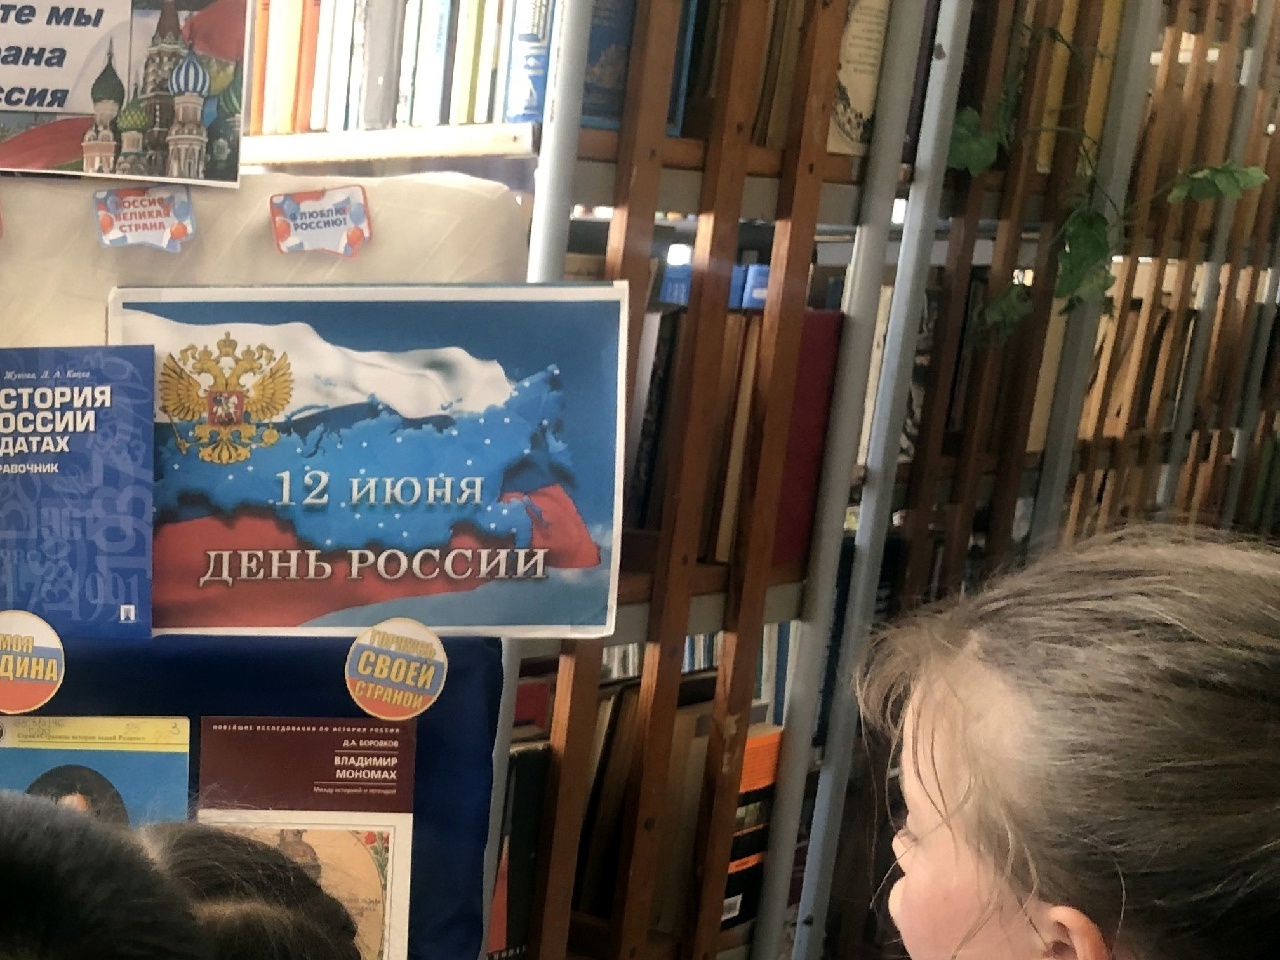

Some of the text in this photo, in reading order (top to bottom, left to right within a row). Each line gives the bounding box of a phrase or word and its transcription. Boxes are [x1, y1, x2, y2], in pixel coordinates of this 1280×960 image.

[46, 6, 104, 27] мы
[115, 196, 165, 209] РОССИЯ
[114, 208, 171, 222] ВЕЛИКАЯ
[300, 207, 347, 221] ЛЮБЛЮ
[119, 221, 166, 233] СТРАНА
[293, 217, 347, 232] РОССИЮ!
[274, 470, 329, 506] 12
[199, 548, 549, 587] ДЕНЬ РОССИИ
[357, 650, 435, 690] СВОЕЙ
[356, 680, 424, 711] СТРАНОЙ
[359, 739, 399, 748] БОРОВКОВ
[334, 756, 398, 767] ВЛАДИМИР
[336, 769, 397, 780] МОНОМАХ
